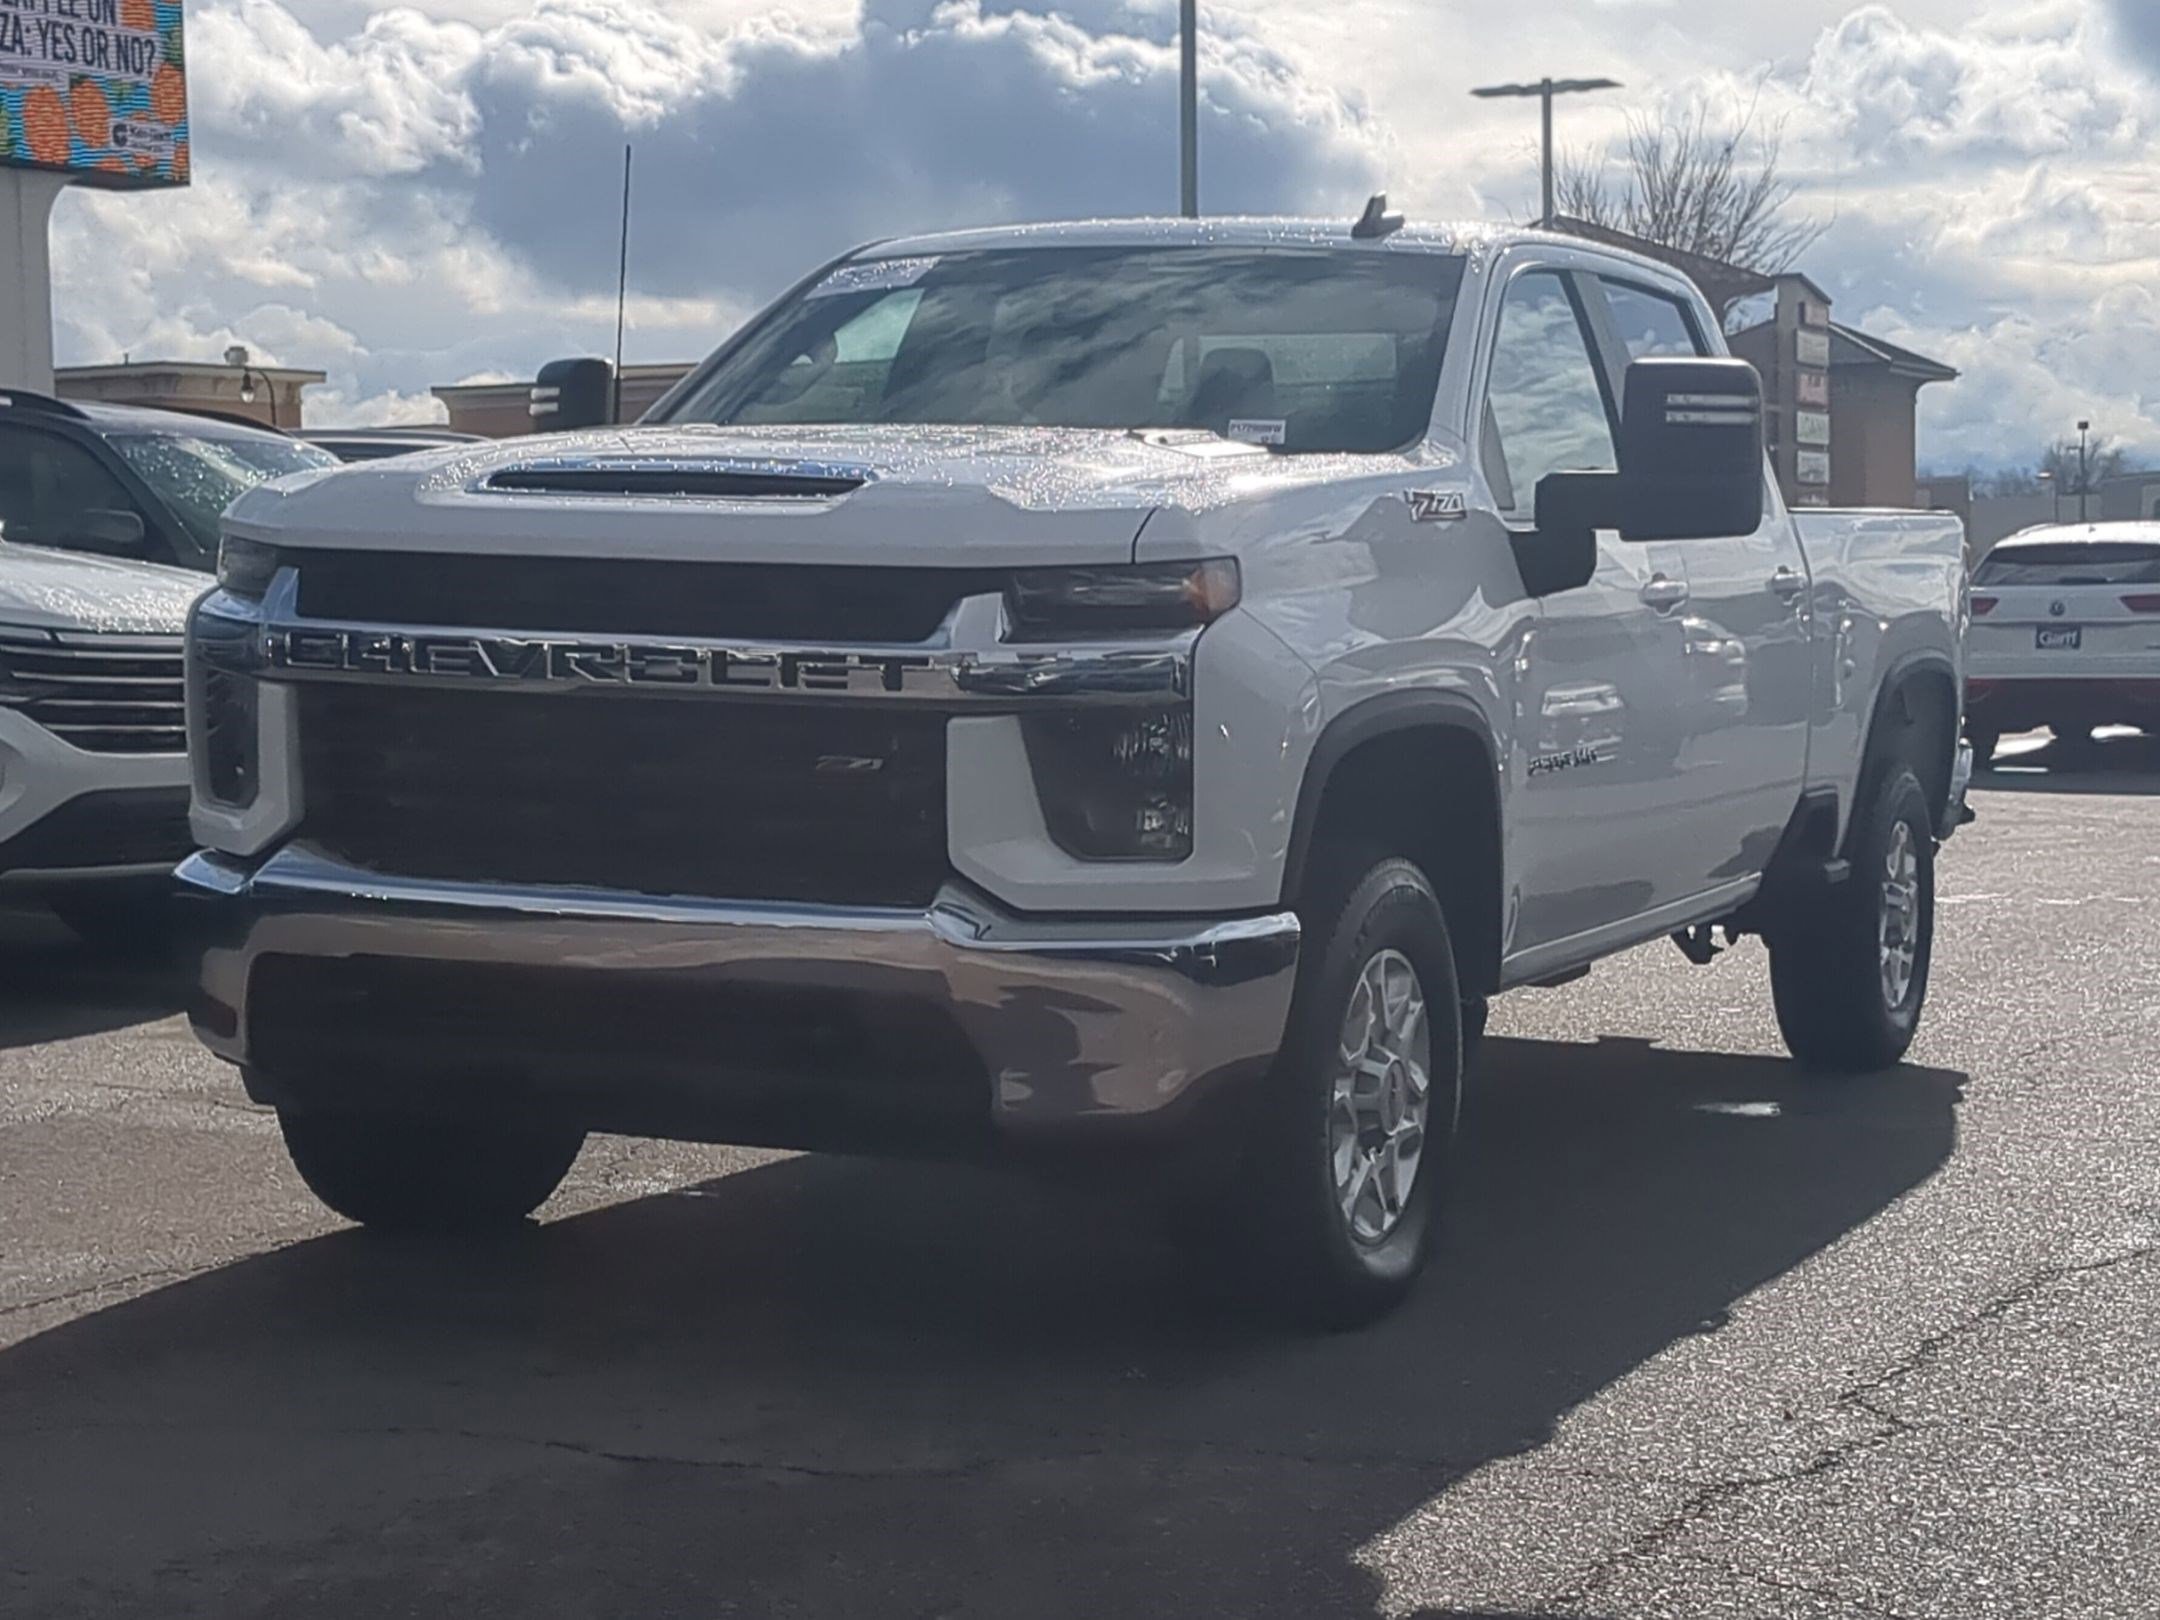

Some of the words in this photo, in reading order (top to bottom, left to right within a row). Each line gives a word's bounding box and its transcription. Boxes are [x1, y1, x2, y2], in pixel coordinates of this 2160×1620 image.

[87, 0, 117, 26] ON
[37, 18, 76, 63] YES
[81, 26, 111, 71] OR
[115, 33, 156, 77] NO?
[266, 630, 936, 691] CHEVROLET
